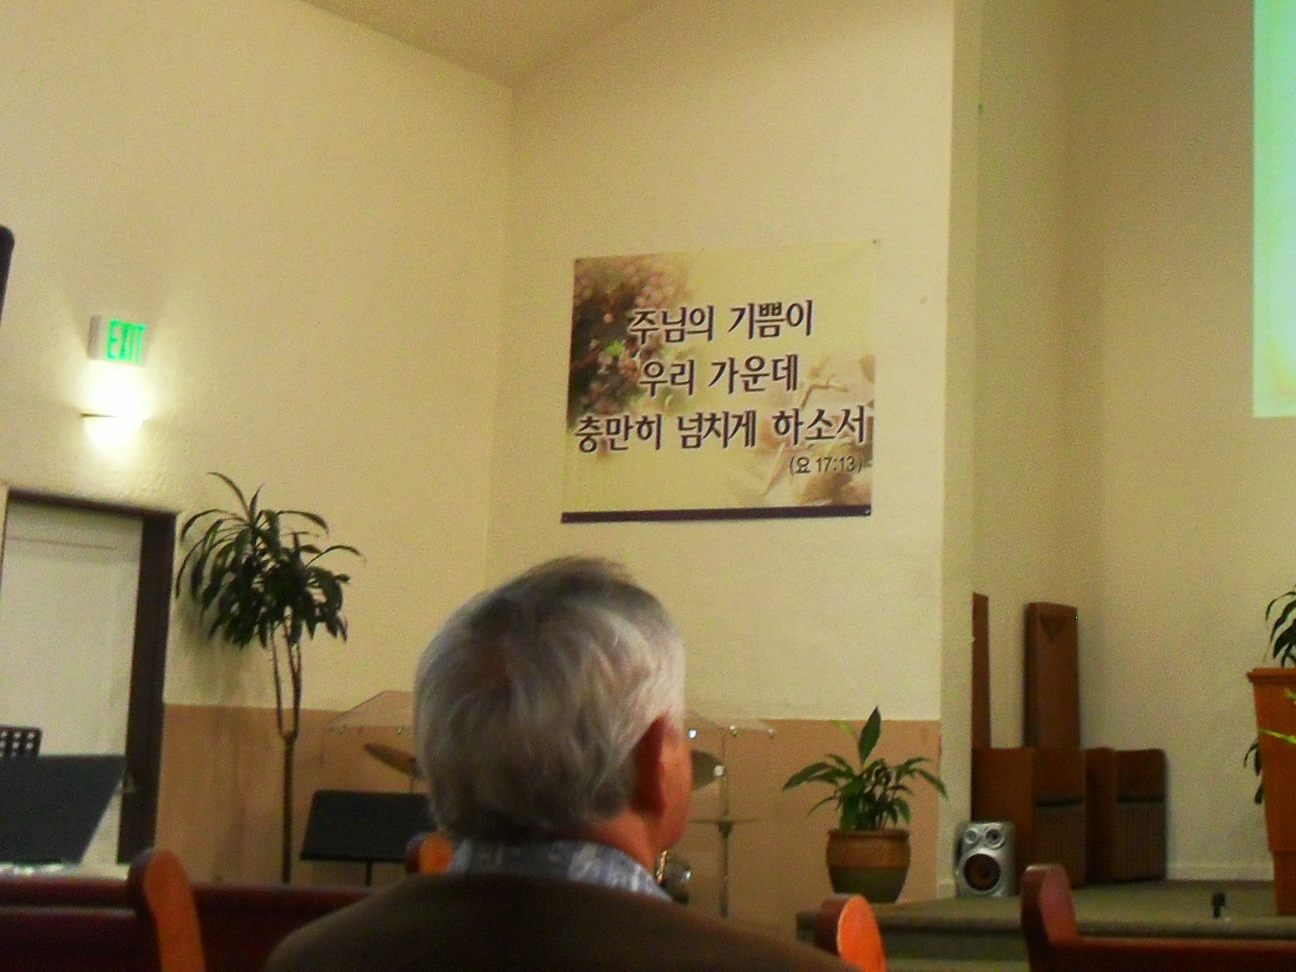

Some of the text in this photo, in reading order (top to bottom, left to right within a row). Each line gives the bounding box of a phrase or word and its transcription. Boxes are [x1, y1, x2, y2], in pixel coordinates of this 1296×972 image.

[107, 319, 146, 364] EXIT
[630, 299, 814, 346] 주님의 기쁨이
[639, 353, 799, 398] 우리 가운데
[574, 405, 866, 454] 충만히 넘치게 하소서
[789, 455, 811, 477] (요
